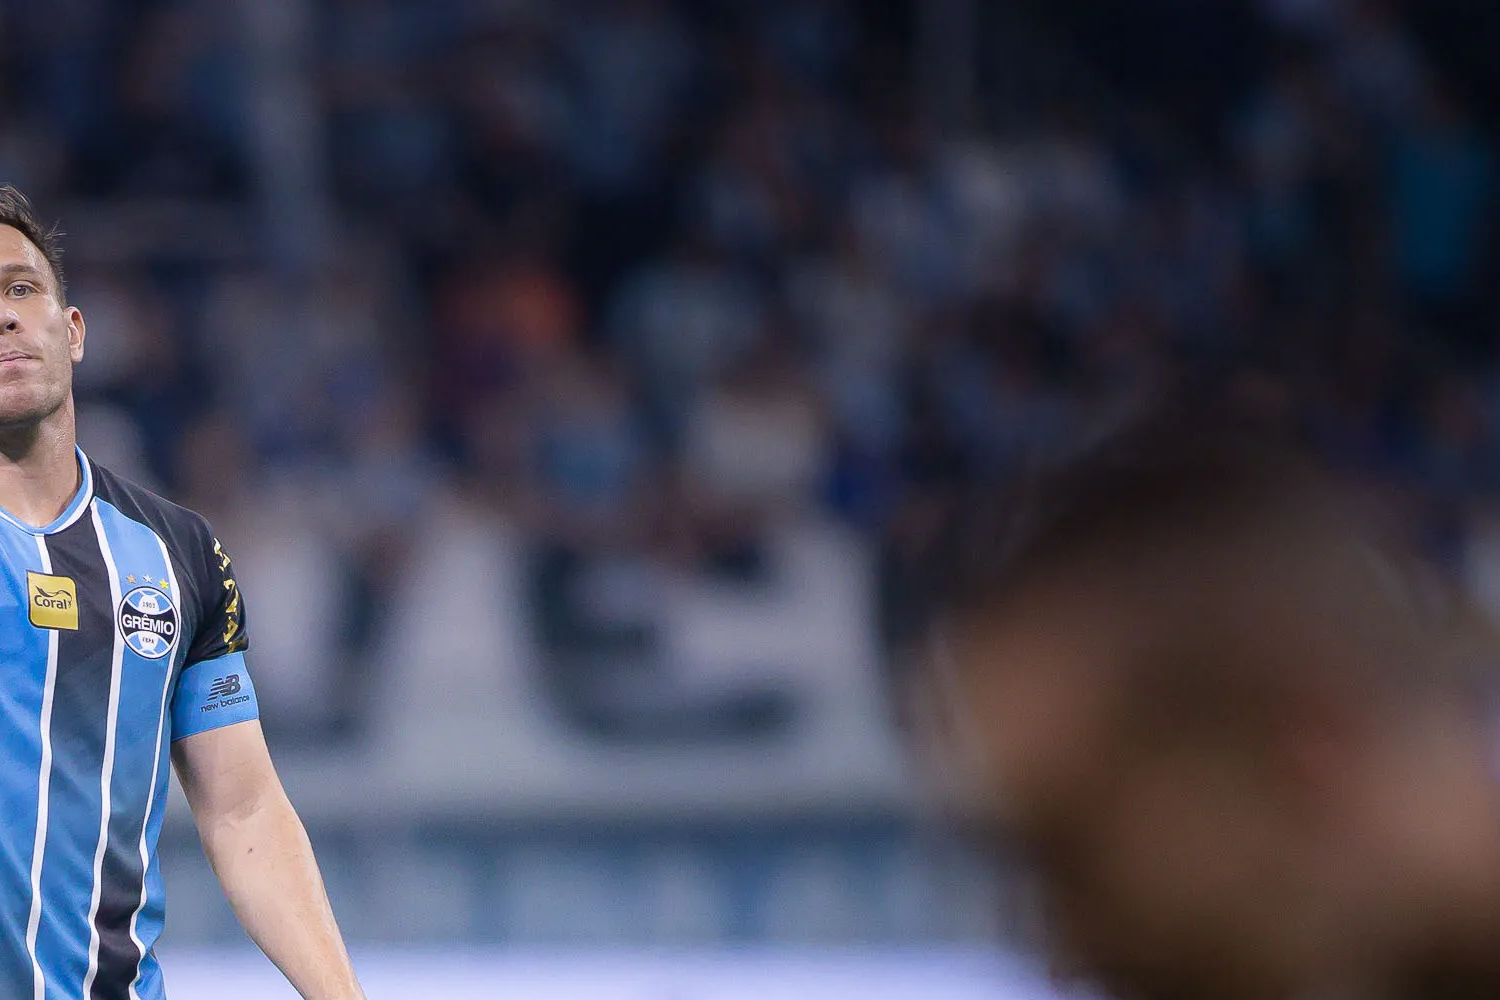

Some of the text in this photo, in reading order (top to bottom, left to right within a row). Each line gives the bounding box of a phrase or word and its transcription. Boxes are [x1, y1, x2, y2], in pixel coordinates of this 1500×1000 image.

[34, 594, 67, 610] Coral
[122, 613, 175, 636] GRÊMIO
[200, 702, 219, 713] new
